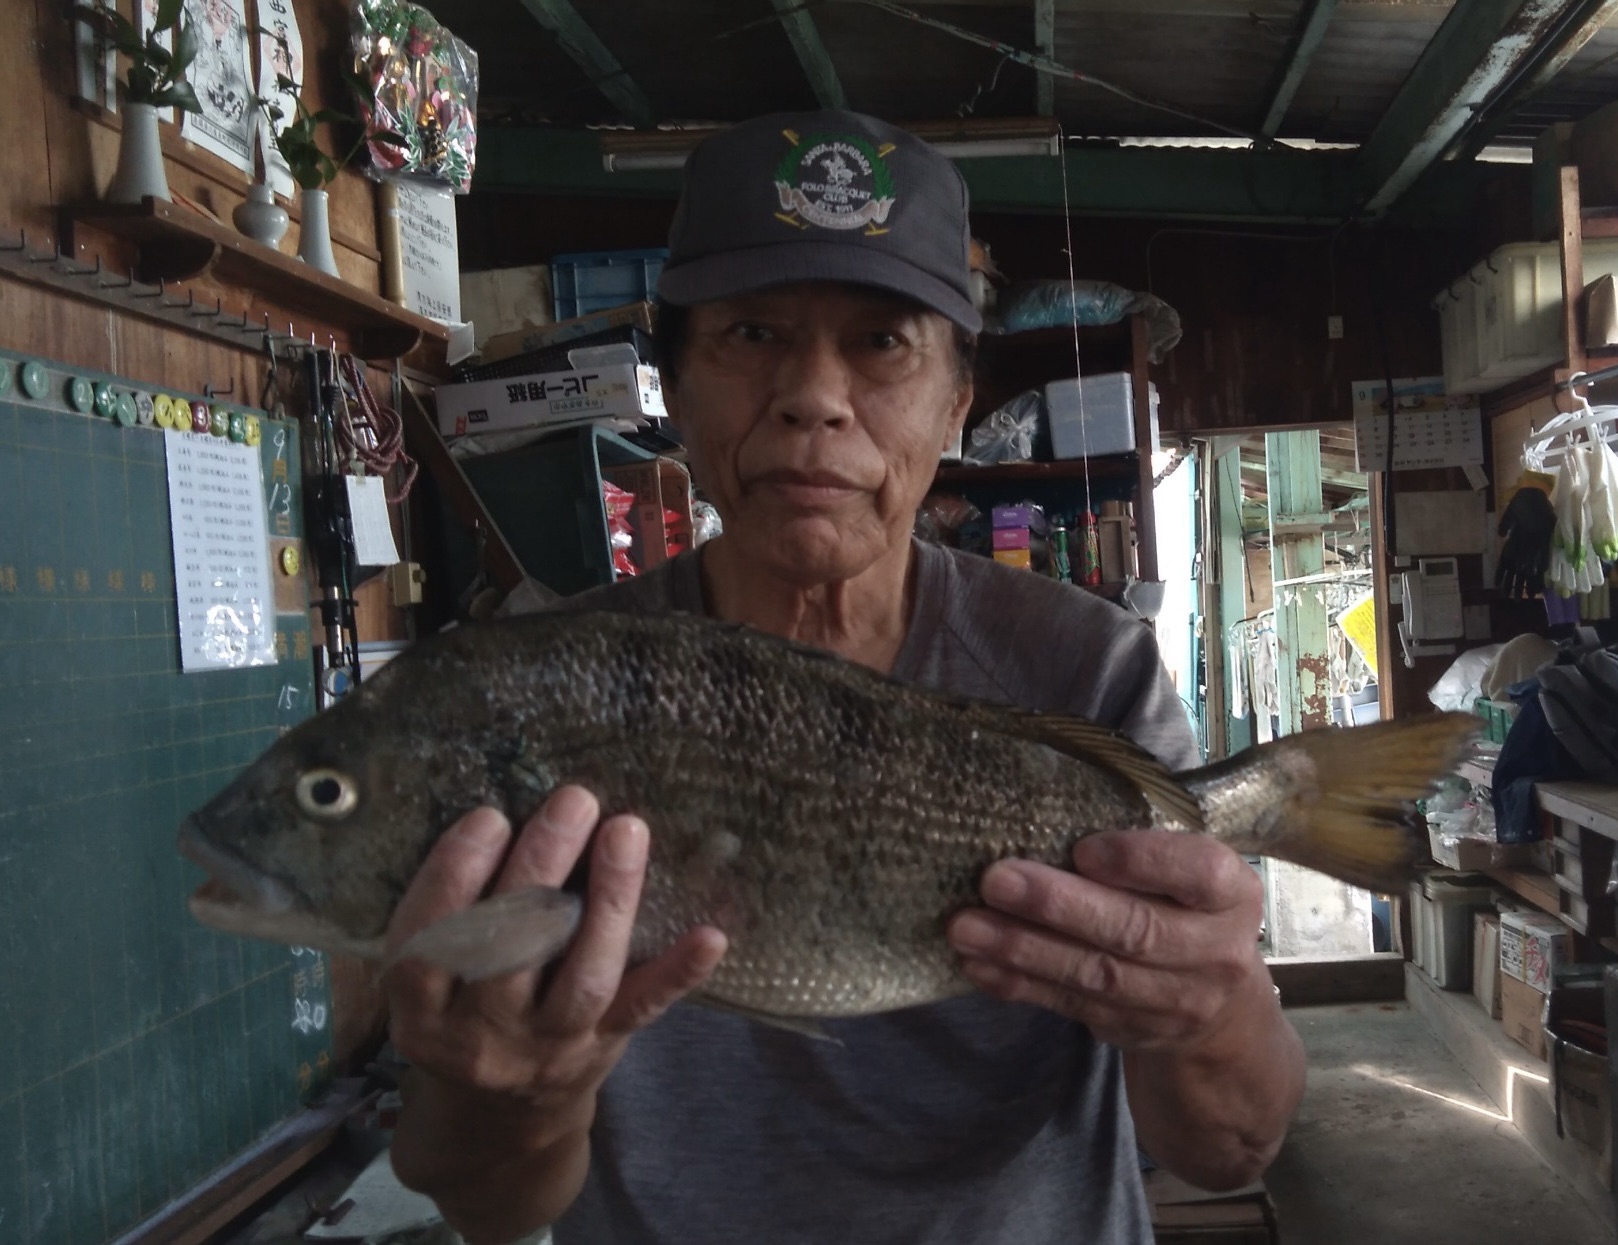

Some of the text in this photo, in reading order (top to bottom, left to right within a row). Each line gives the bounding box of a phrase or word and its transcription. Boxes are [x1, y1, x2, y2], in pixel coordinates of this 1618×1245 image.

[801, 141, 873, 176] SANTA BARBARA
[801, 182, 825, 192] POLO
[823, 193, 849, 204] CLUB
